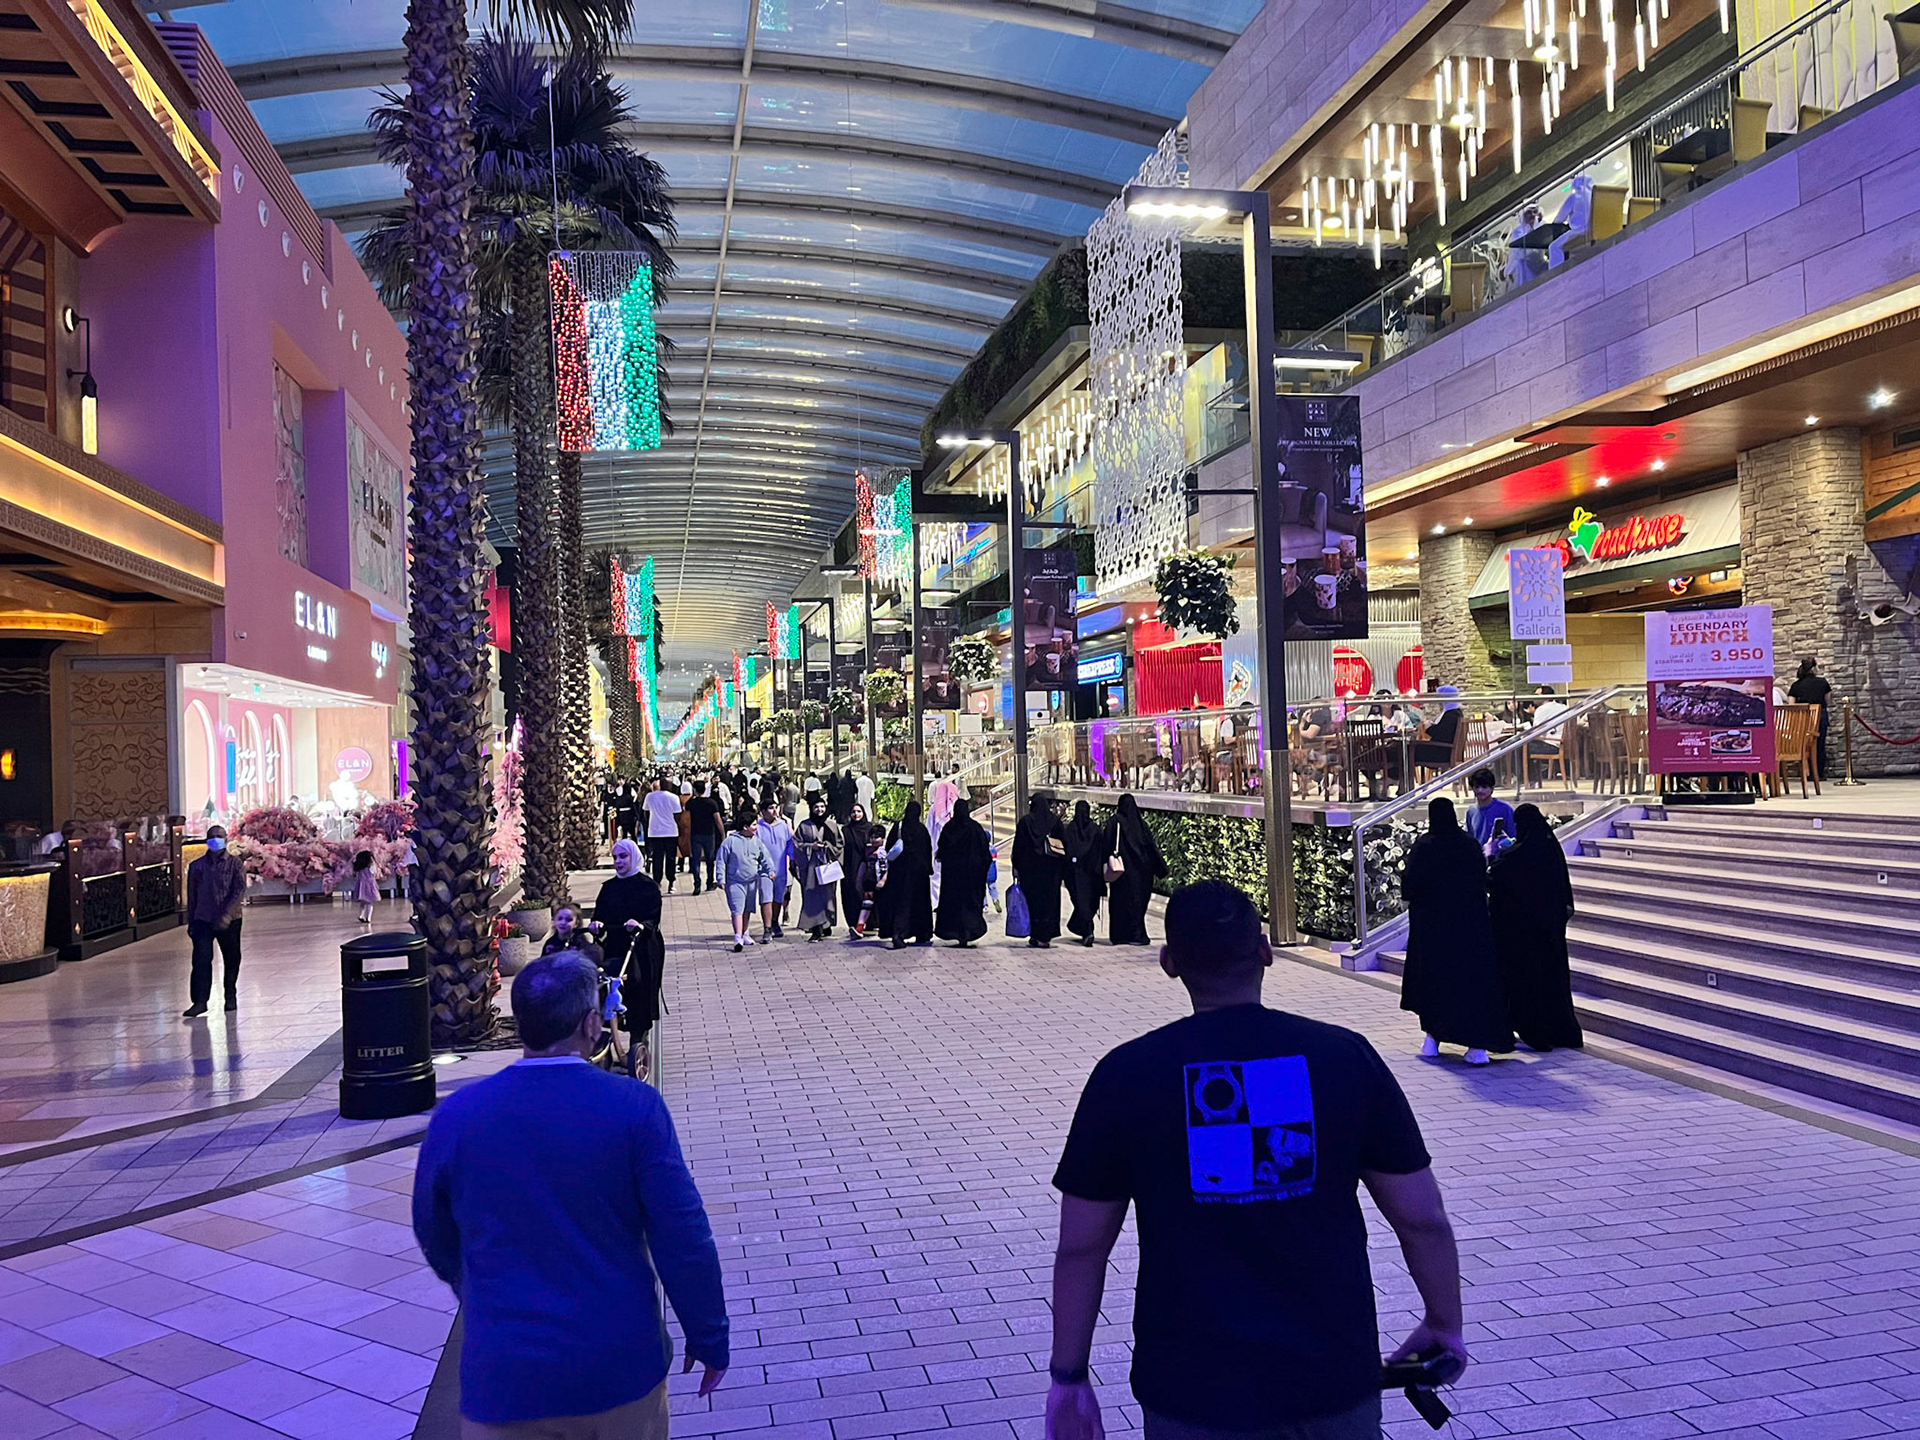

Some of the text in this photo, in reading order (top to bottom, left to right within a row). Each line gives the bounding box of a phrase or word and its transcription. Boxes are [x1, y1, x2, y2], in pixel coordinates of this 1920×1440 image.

[1304, 427, 1332, 438] NEW
[295, 590, 337, 640] EL&N
[1515, 605, 1562, 622] غاليريا
[1516, 623, 1562, 636] Galleria
[1670, 619, 1749, 632] LEGENDARY
[1669, 629, 1750, 646] LUNCH
[1711, 647, 1764, 662] 3.950
[357, 1046, 405, 1058] LITTER
